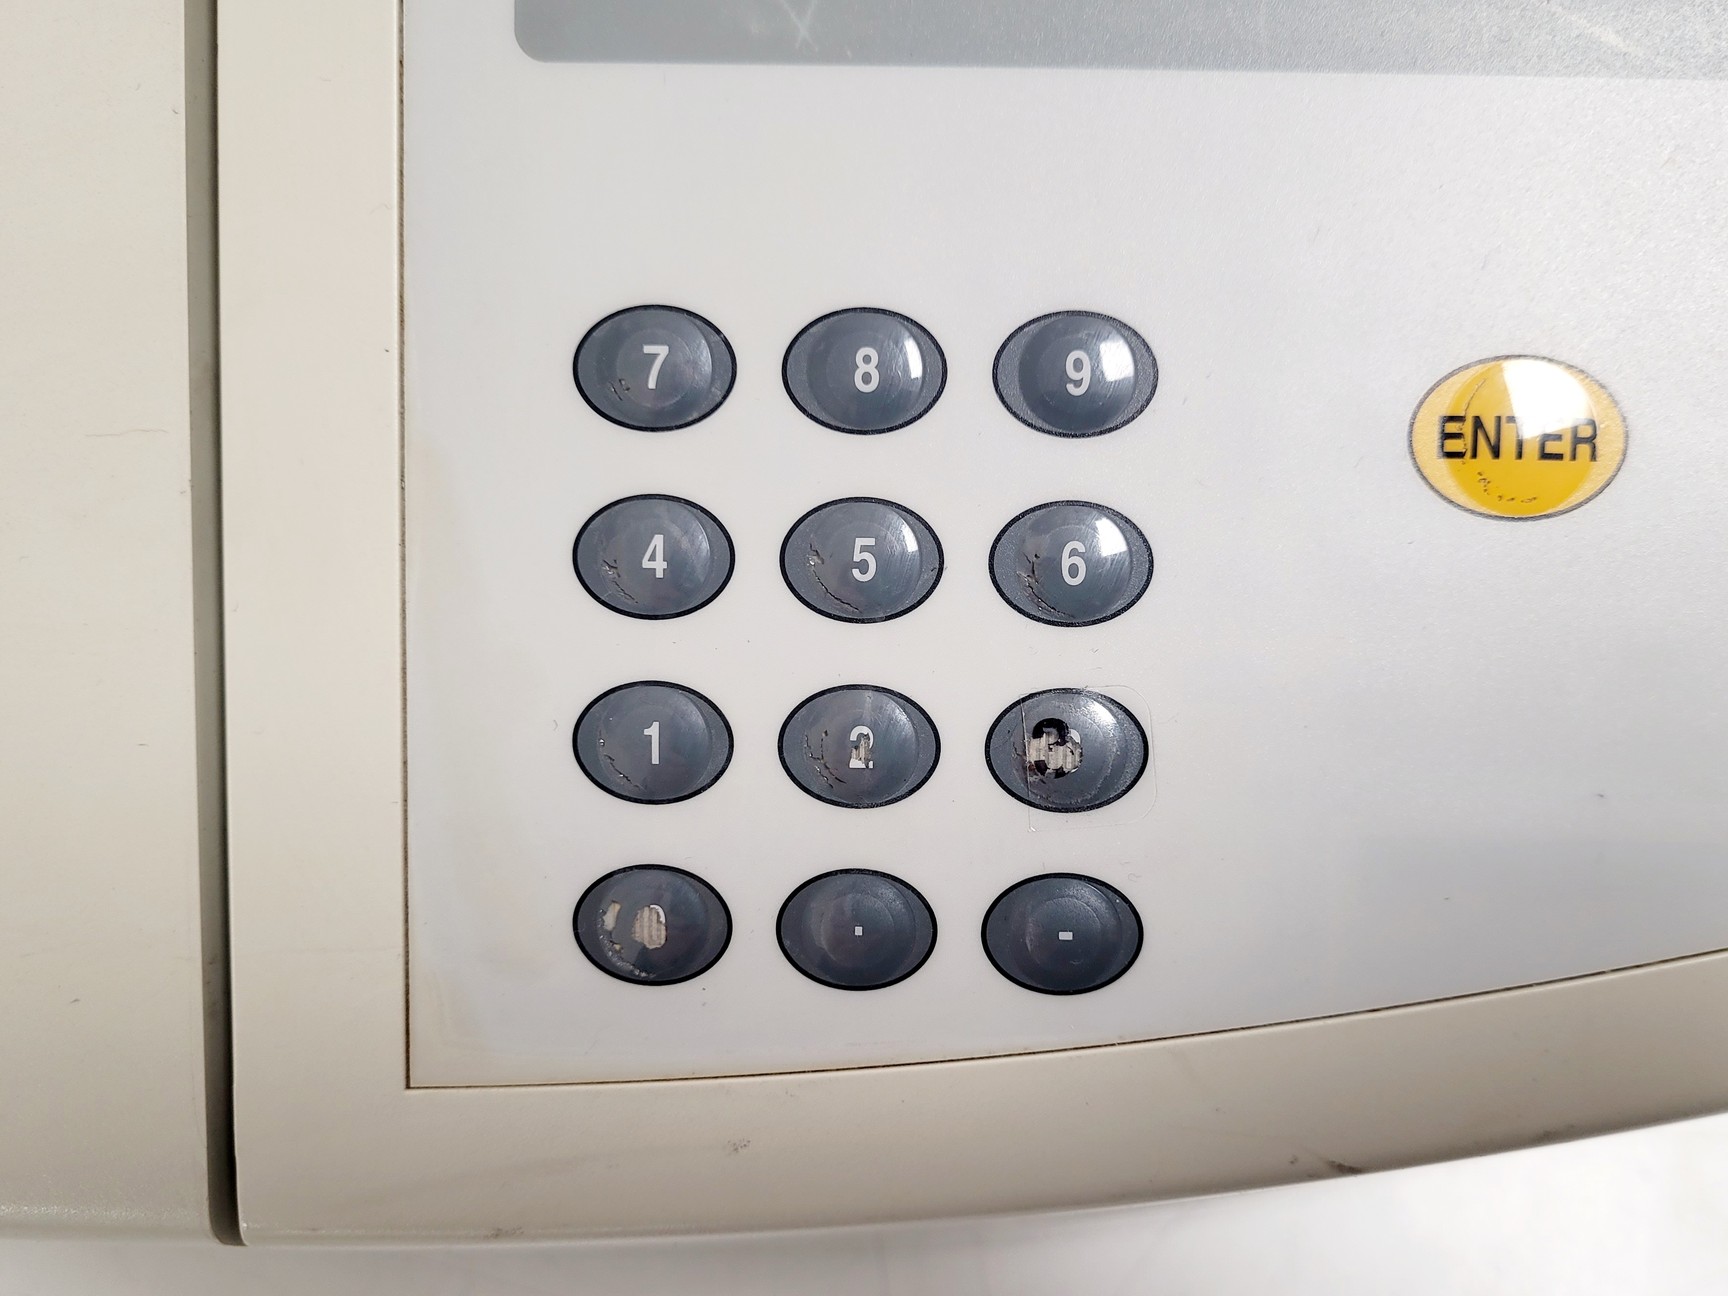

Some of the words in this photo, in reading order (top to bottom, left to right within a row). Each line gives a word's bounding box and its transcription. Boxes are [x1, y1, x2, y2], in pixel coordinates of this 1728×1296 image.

[643, 345, 669, 390] 7
[854, 346, 880, 393] 8
[1065, 349, 1092, 396] 9
[1438, 415, 1598, 462] ENTER
[641, 534, 668, 578] 4
[851, 537, 877, 582] 5
[1061, 540, 1087, 586] 6
[643, 721, 660, 766] 1
[849, 725, 874, 769] 2
